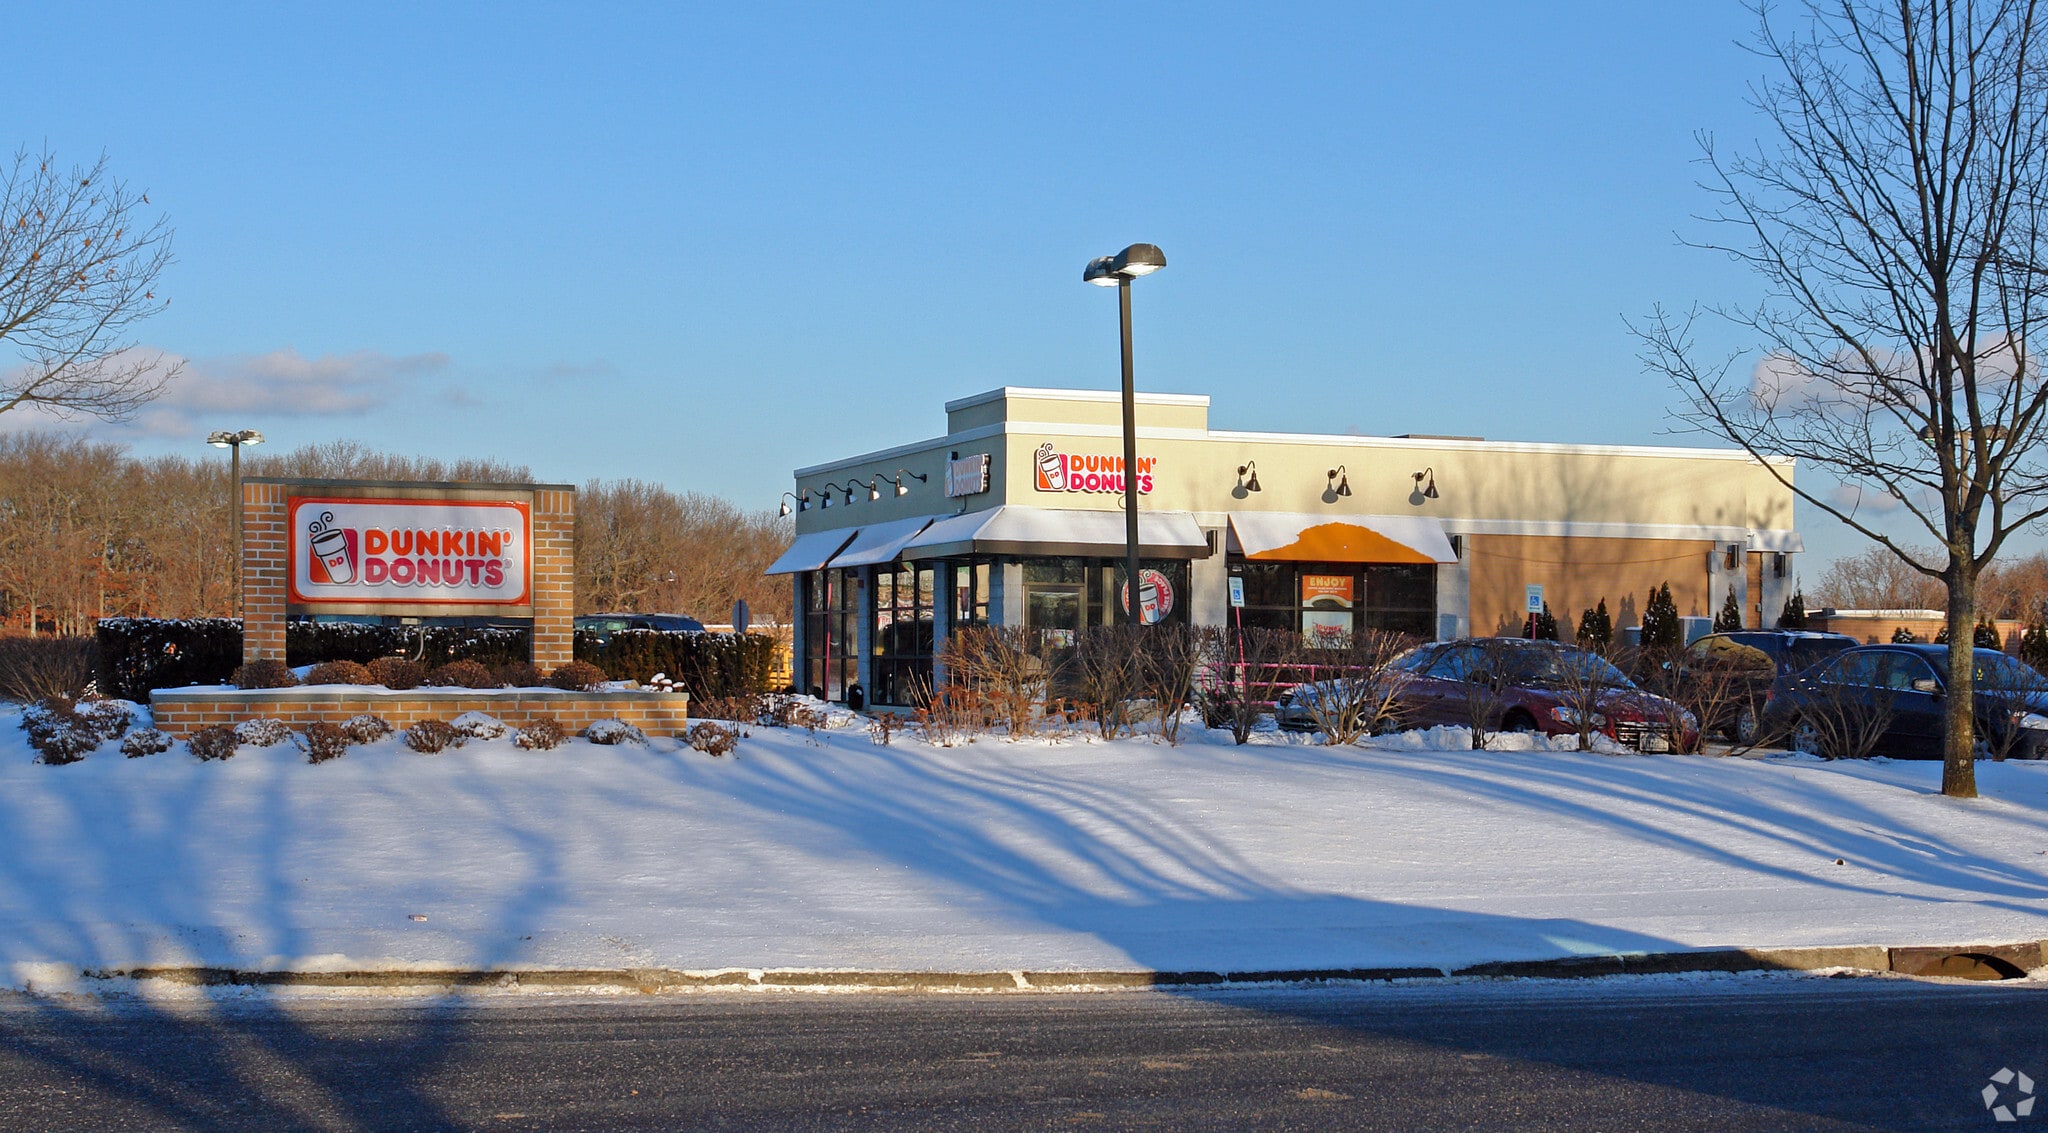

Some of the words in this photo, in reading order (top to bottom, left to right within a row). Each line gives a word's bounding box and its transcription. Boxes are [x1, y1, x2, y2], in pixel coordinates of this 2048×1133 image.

[1070, 455, 1157, 473] DUNKN'
[365, 529, 511, 556] DUNKIN'
[365, 557, 504, 585] DONUTS
[1309, 577, 1346, 587] ENJOY
